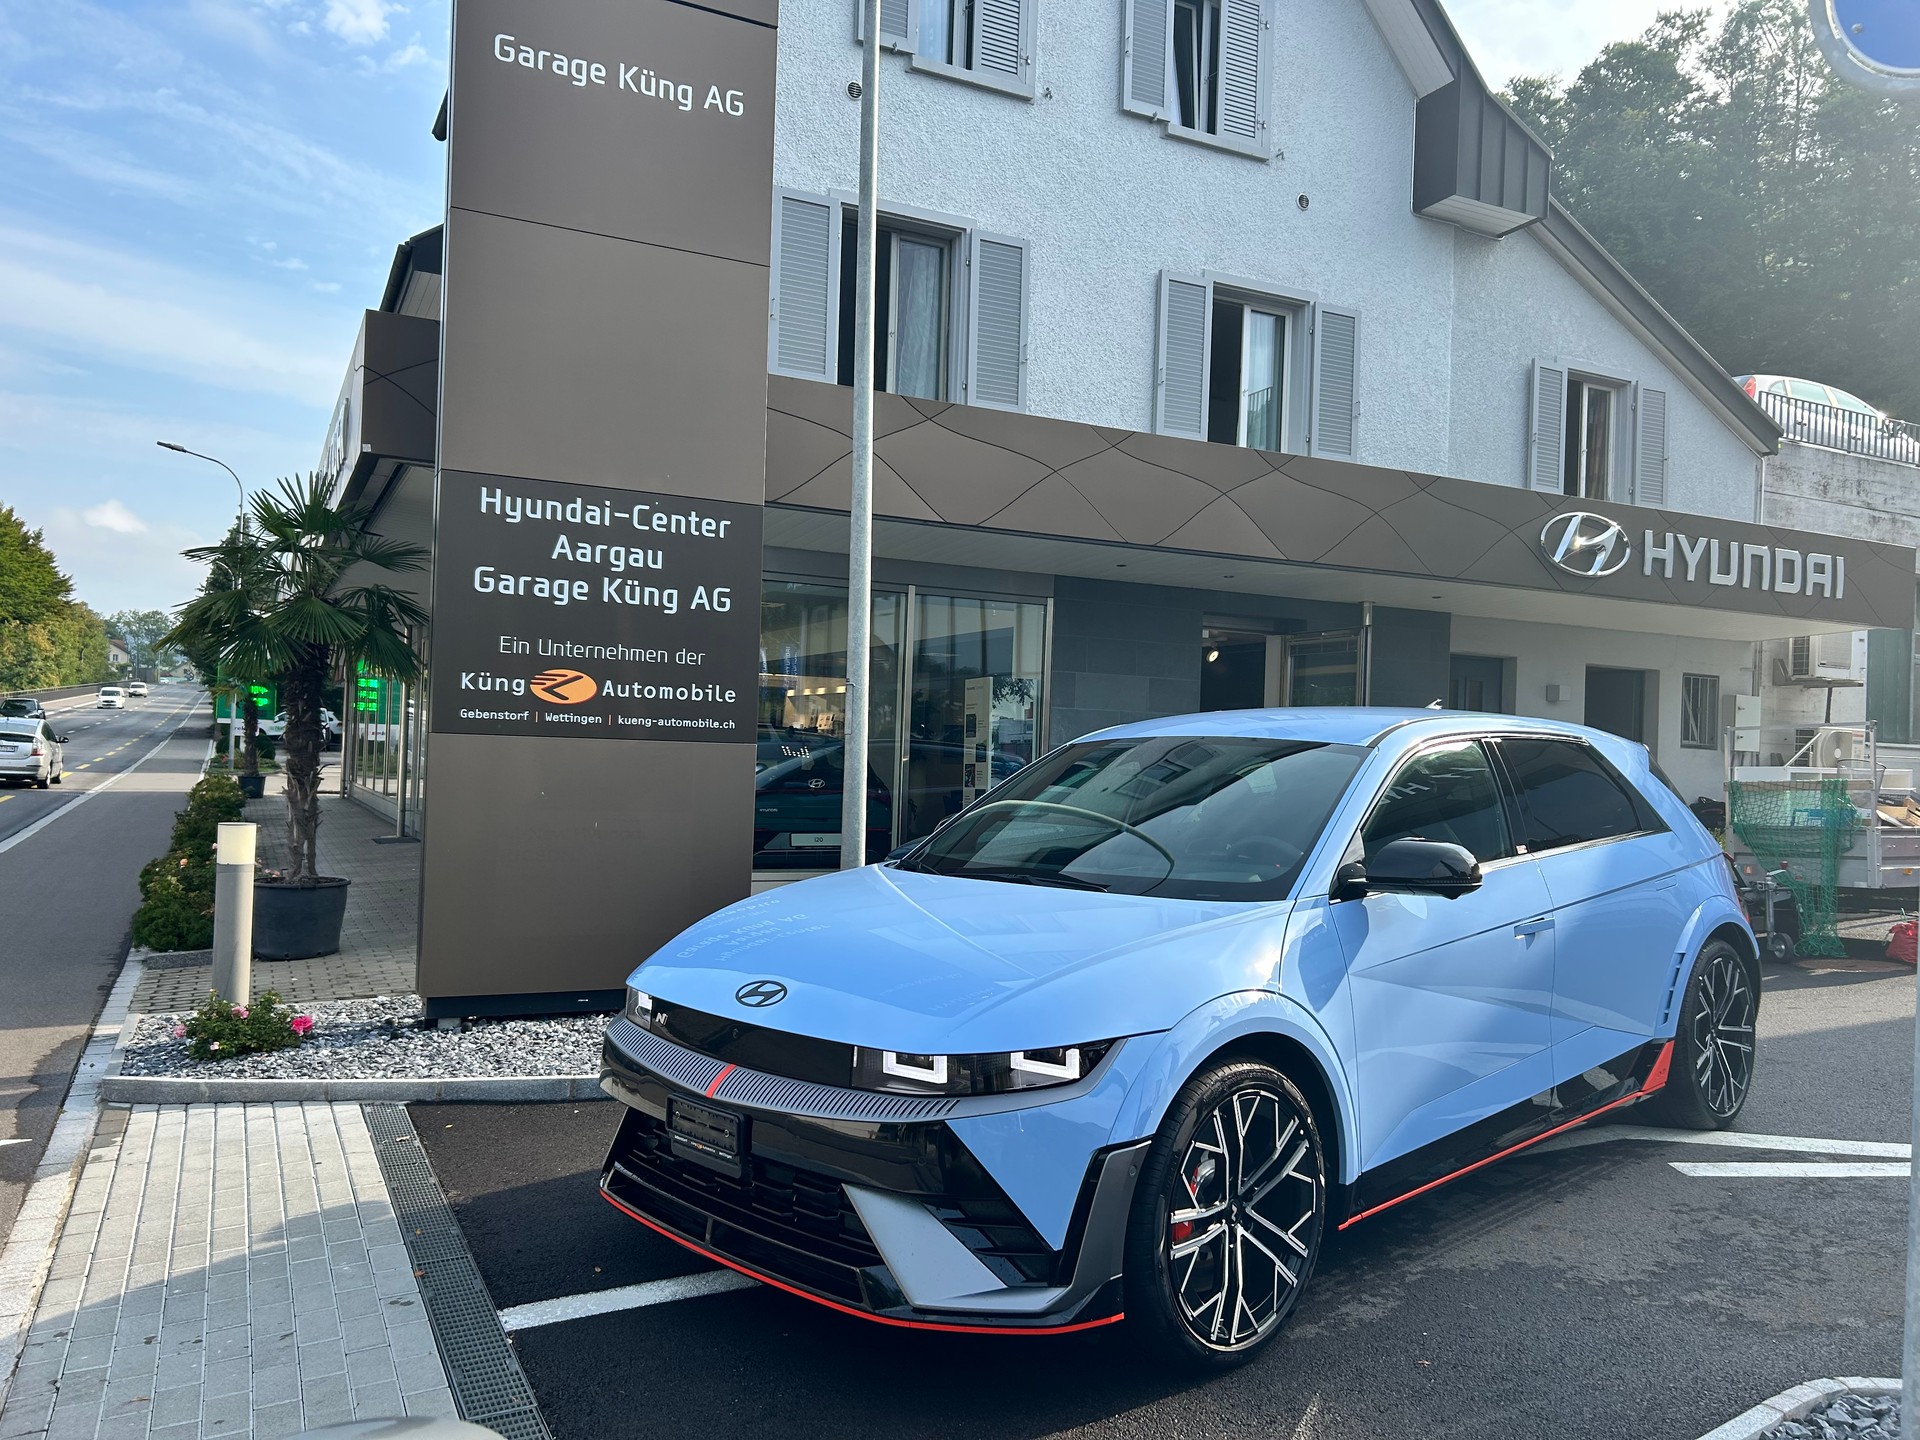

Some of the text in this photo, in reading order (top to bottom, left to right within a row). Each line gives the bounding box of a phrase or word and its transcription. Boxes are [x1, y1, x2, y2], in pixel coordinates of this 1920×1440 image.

[494, 33, 744, 117] Garage Küng AG
[480, 486, 731, 538] Hyundai-Center
[551, 534, 663, 572] Aargau
[1643, 529, 1845, 599] HYUNDAI
[474, 565, 731, 615] Garage Küng AG
[499, 635, 706, 666] Ein Unternehmen der
[460, 671, 737, 703] Küng Automobile
[460, 708, 735, 729] Gebenstorf Wettingen kueng-automobile.ch
